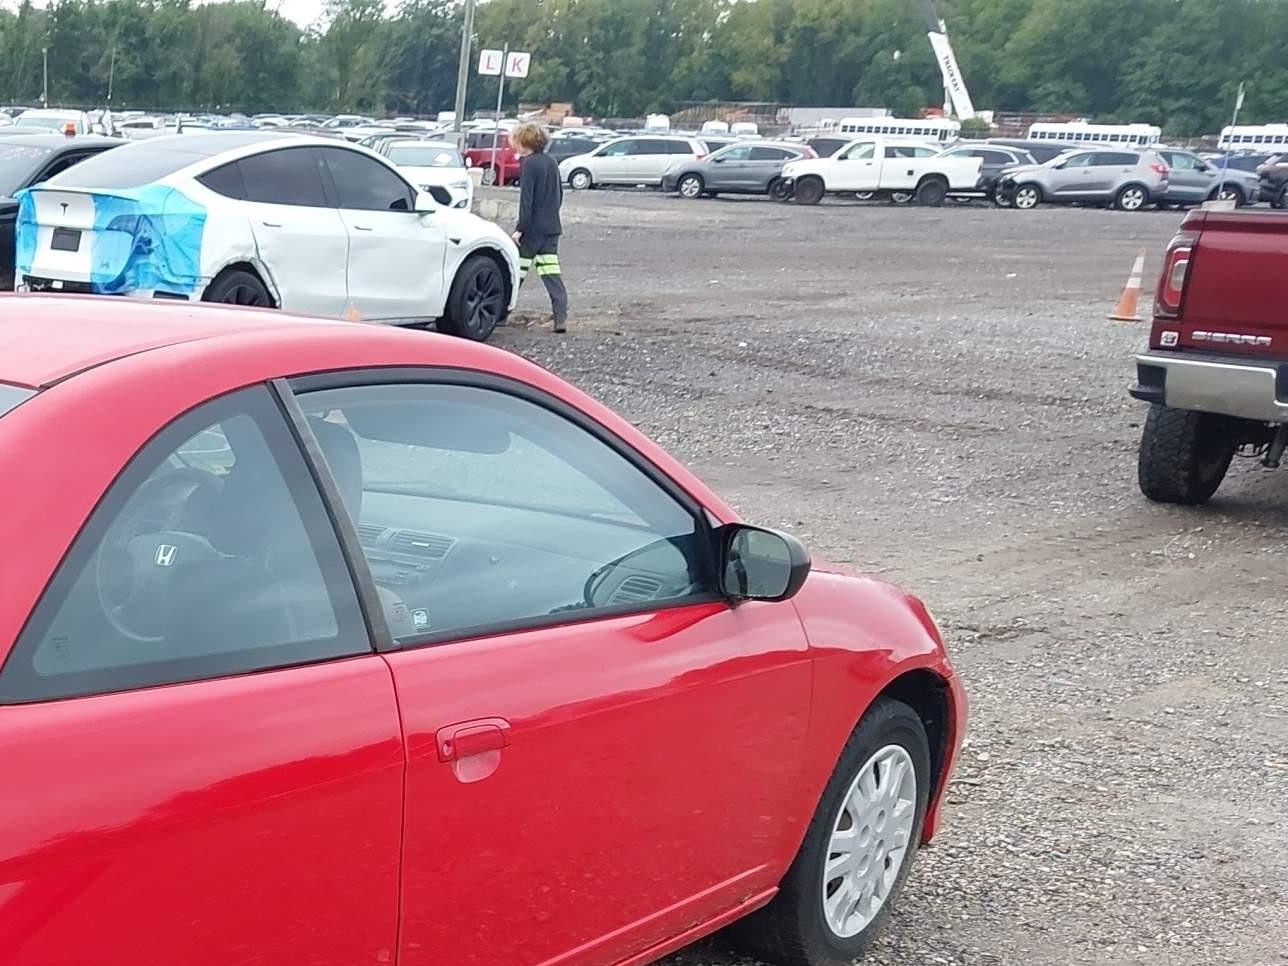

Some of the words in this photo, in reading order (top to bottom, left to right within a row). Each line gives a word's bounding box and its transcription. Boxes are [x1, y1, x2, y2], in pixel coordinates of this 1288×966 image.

[486, 55, 496, 70] L
[512, 57, 524, 73] K
[1192, 330, 1273, 346] SIERRA
